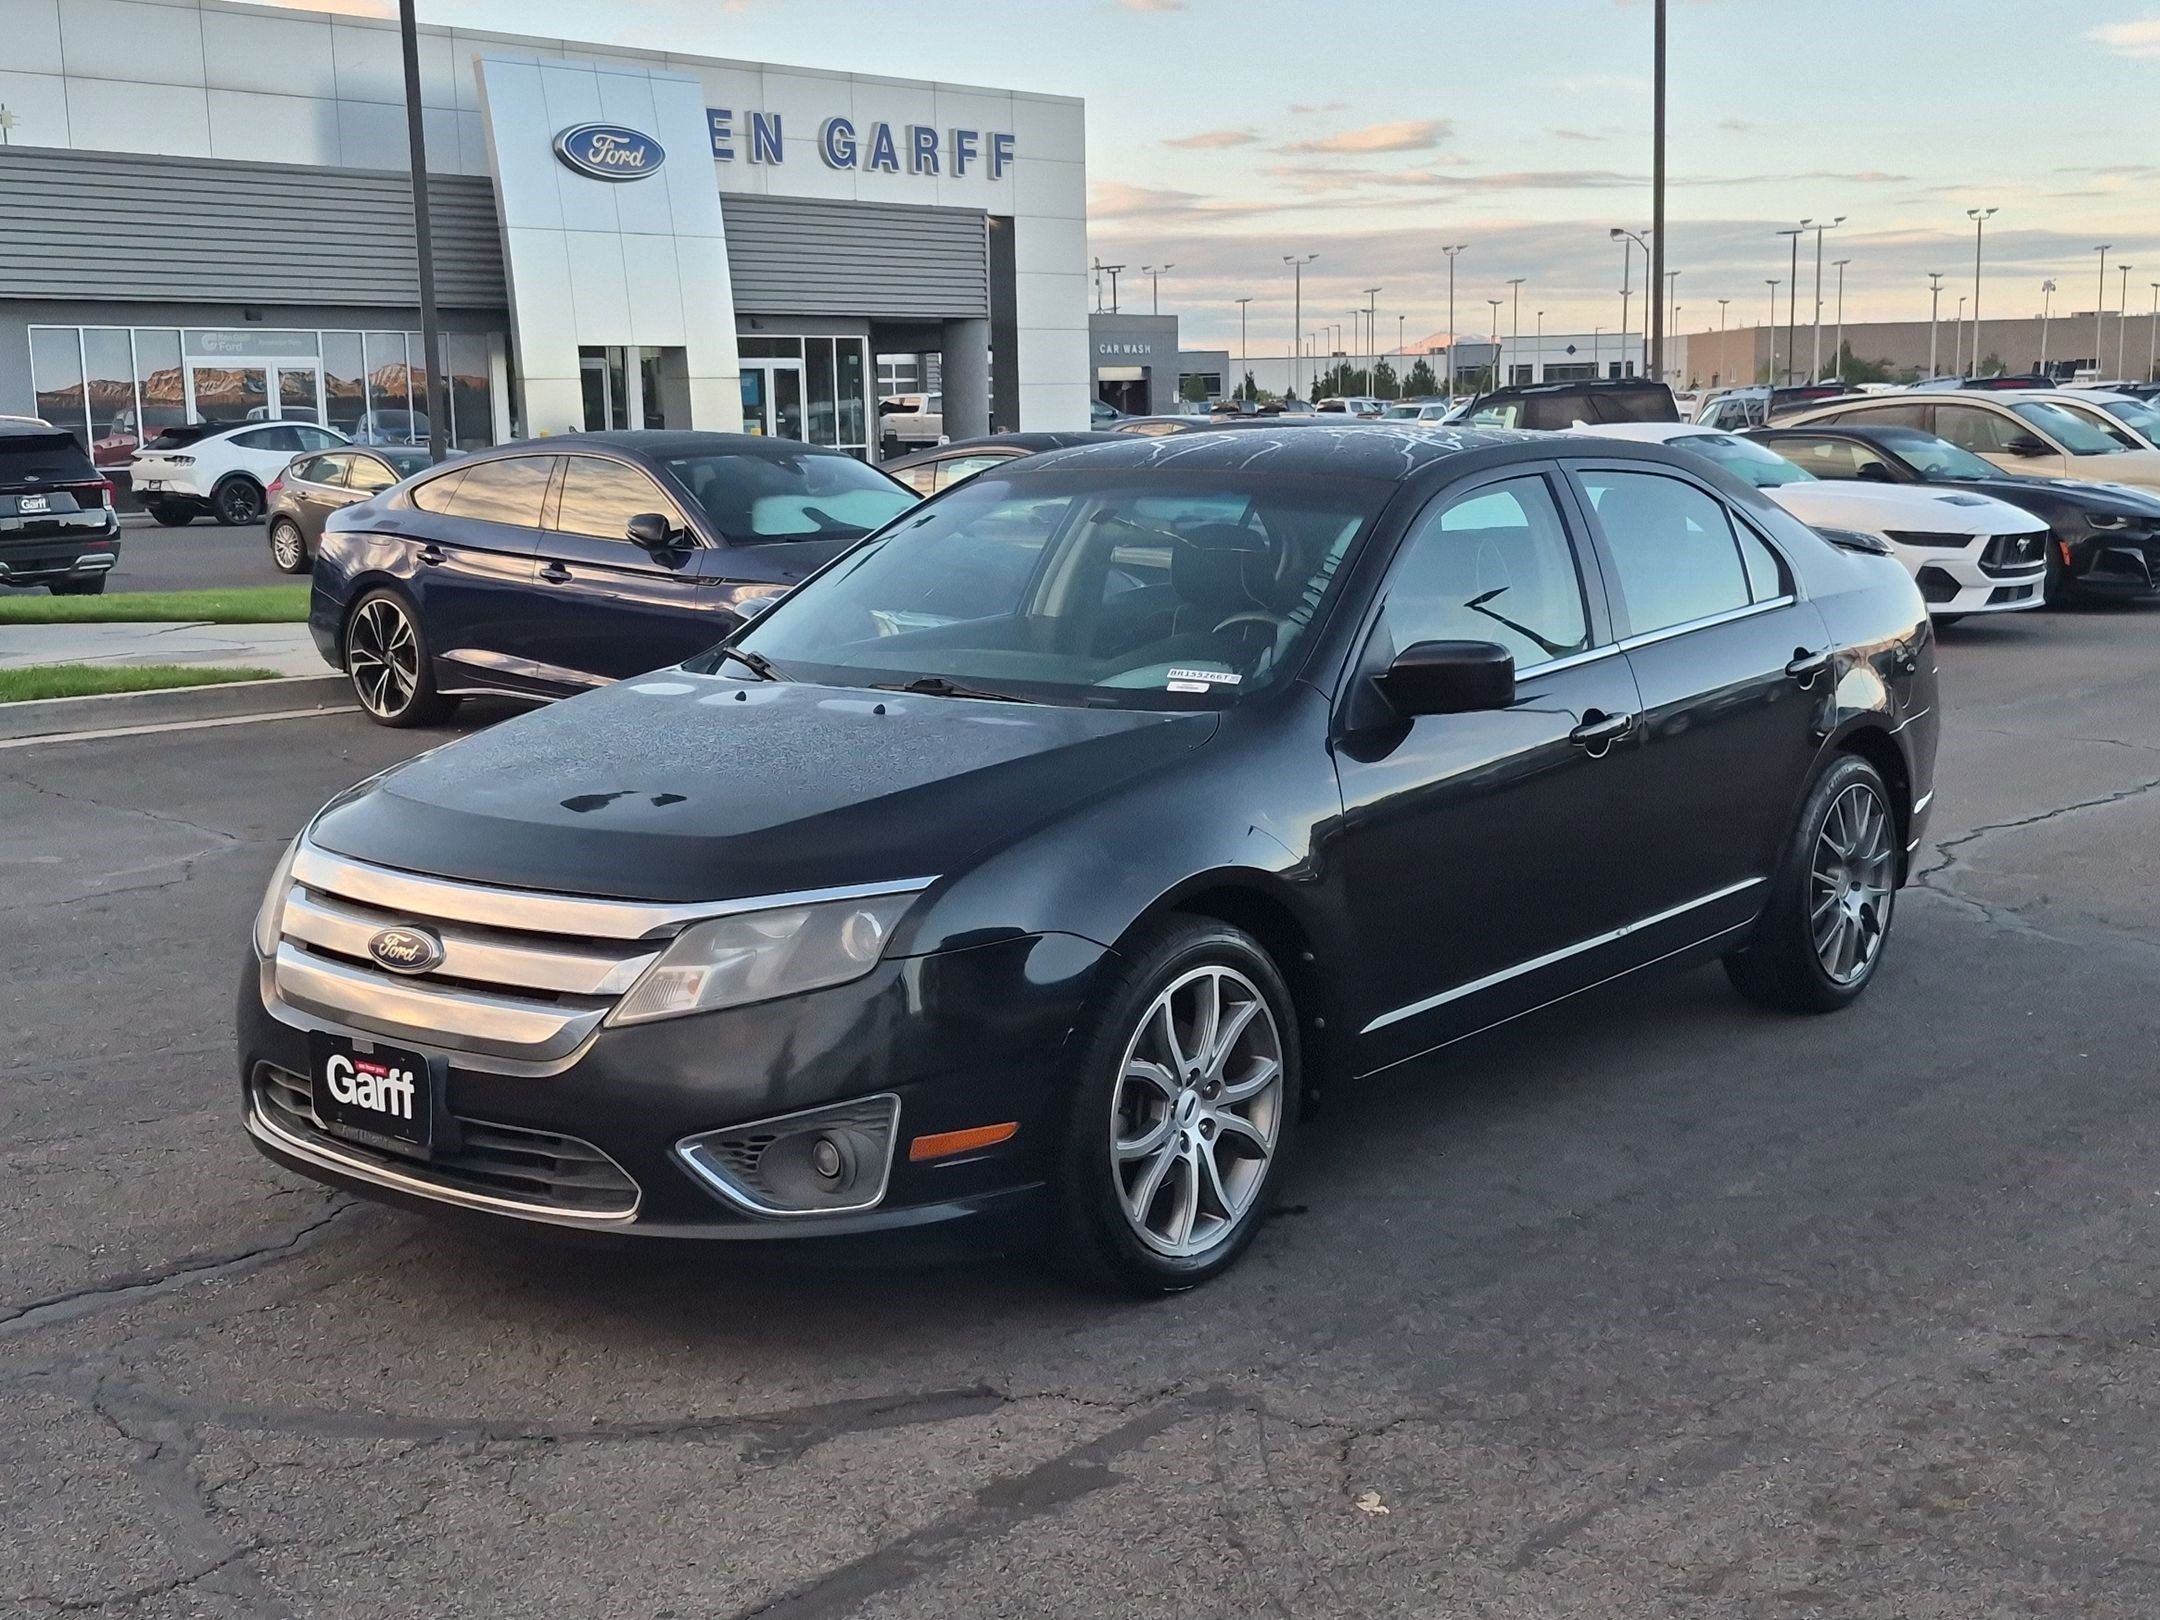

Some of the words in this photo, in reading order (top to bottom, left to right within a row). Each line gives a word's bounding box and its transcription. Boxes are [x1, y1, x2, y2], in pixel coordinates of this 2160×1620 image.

[588, 133, 646, 167] Ford
[818, 115, 1016, 181] GARFF
[219, 342, 243, 352] Ford
[1099, 344, 1120, 354] CAR
[1122, 344, 1151, 354] WASH
[378, 933, 420, 962] Ford
[326, 1054, 415, 1120] Garff
